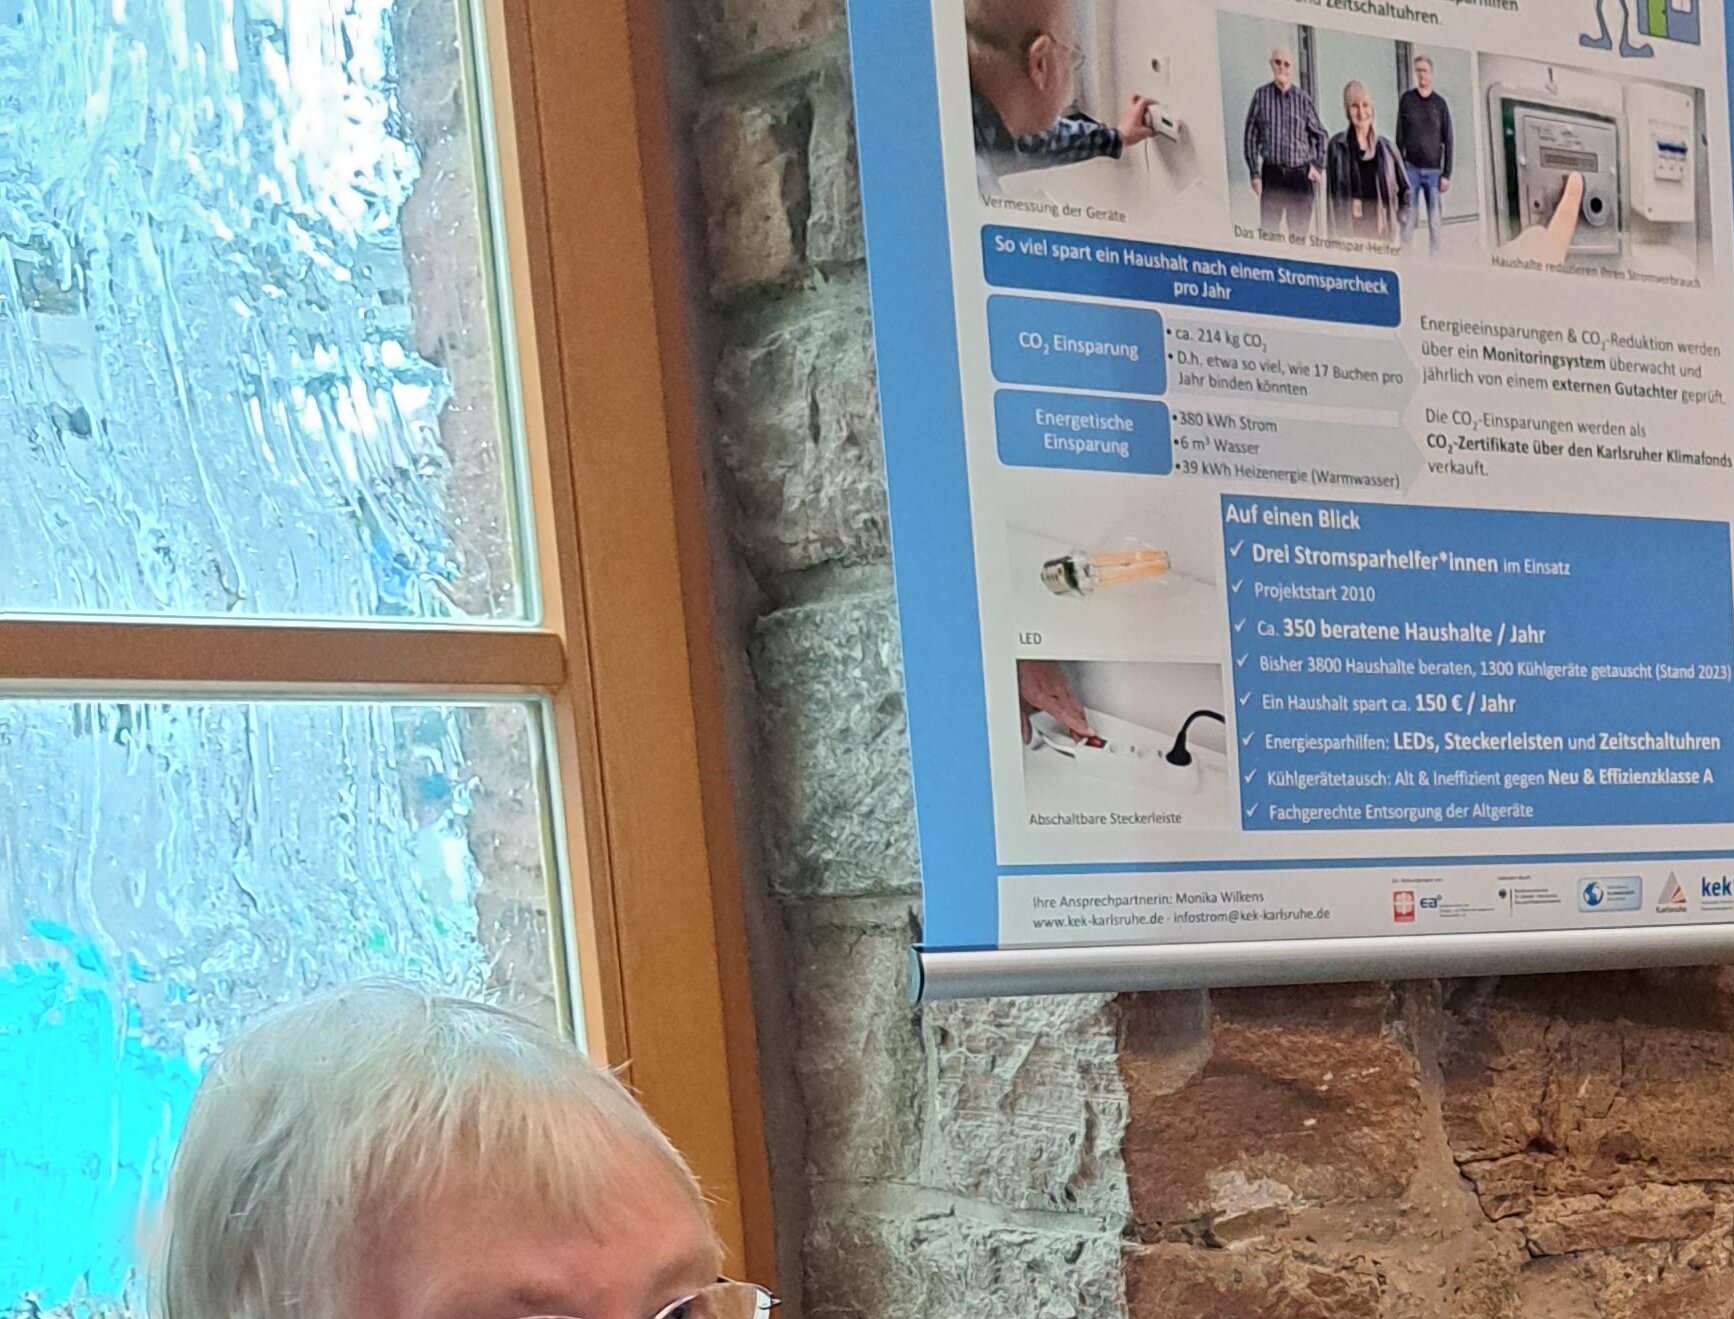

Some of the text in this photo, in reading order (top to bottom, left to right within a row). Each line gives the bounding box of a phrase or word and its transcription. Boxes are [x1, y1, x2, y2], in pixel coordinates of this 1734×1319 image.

[982, 194, 1127, 223] Vermessung der Geräte
[1234, 225, 1400, 257] Das Team der Stromspar-Helfer
[995, 234, 1389, 295] So viel spart ein Haushalt nach einem Stromsparcheck
[1492, 256, 1543, 271] Haushalte
[1628, 270, 1701, 288] Stromverbrauch
[1173, 281, 1232, 300] pro Jahr
[1053, 334, 1139, 361] Einsparung
[1175, 328, 1193, 342] ca.
[1198, 328, 1221, 344] 214
[1225, 330, 1240, 349] kg
[1420, 315, 1563, 345] Energieeinsparungen
[1567, 328, 1577, 344] &
[1677, 342, 1721, 358] werden
[1177, 350, 1403, 386] D.h. etwa so viel, wie 17 Buchen pro
[1421, 341, 1702, 379] über ein Monitoringsystem überwacht und
[1178, 372, 1308, 396] Jahr binden könnten
[1423, 367, 1726, 405] jährlich von einem externen Gutachter geprüft.
[1035, 408, 1134, 432] Energetische
[1180, 412, 1278, 433] 380 kWh Strom
[1425, 408, 1449, 424] Die
[1577, 421, 1626, 436] werden
[1629, 423, 1647, 438] als
[1044, 433, 1129, 458] Einsparung
[1180, 438, 1189, 450] 6
[1213, 438, 1260, 455] Wasser
[1533, 440, 1564, 456] über
[1567, 442, 1593, 458] den
[1596, 444, 1663, 462] Karlsruher
[1666, 450, 1733, 468] Klimafonds
[1182, 460, 1401, 489] 39 kWh Heizenergie (Warmwasser)
[1427, 460, 1489, 476] verkauft.
[1225, 503, 1361, 530] Auf einen Blick
[1252, 543, 1290, 564] Drei
[1503, 558, 1521, 573] im
[1524, 558, 1571, 576] Einsatz
[1254, 582, 1376, 602] Projektstart 2010
[1019, 632, 1042, 645] LED
[1257, 618, 1546, 646] Ca. 350 beratene Haushalte / Jahr
[1259, 656, 1732, 683] Bisher 3800 Haushalte beraten, 1300 Kühlgeräte getauscht (Stand 2023)
[1262, 691, 1517, 716] Ein Haushalt spart ca. 150 € / Jahr
[1265, 731, 1721, 755] Energiesparhilfen: LEDs, Steckerleisten und Zeitschaltuhren
[1267, 768, 1714, 790] Kühlgerätetausch: Alt & Ineffizient gegen Neu & Effizienzklasse A
[1029, 811, 1182, 826] Abschaltbare Steckerleiste
[1269, 803, 1534, 823] Fachgerechte Entsorgung der Altgeräte
[1702, 875, 1732, 897] kek
[1033, 891, 1265, 909] Ihre Ansprechpartnerin: Monika Wilkens
[1033, 909, 1330, 929] www.kek-karlsruhe.de infostrom@kek-karlsruhe.de
